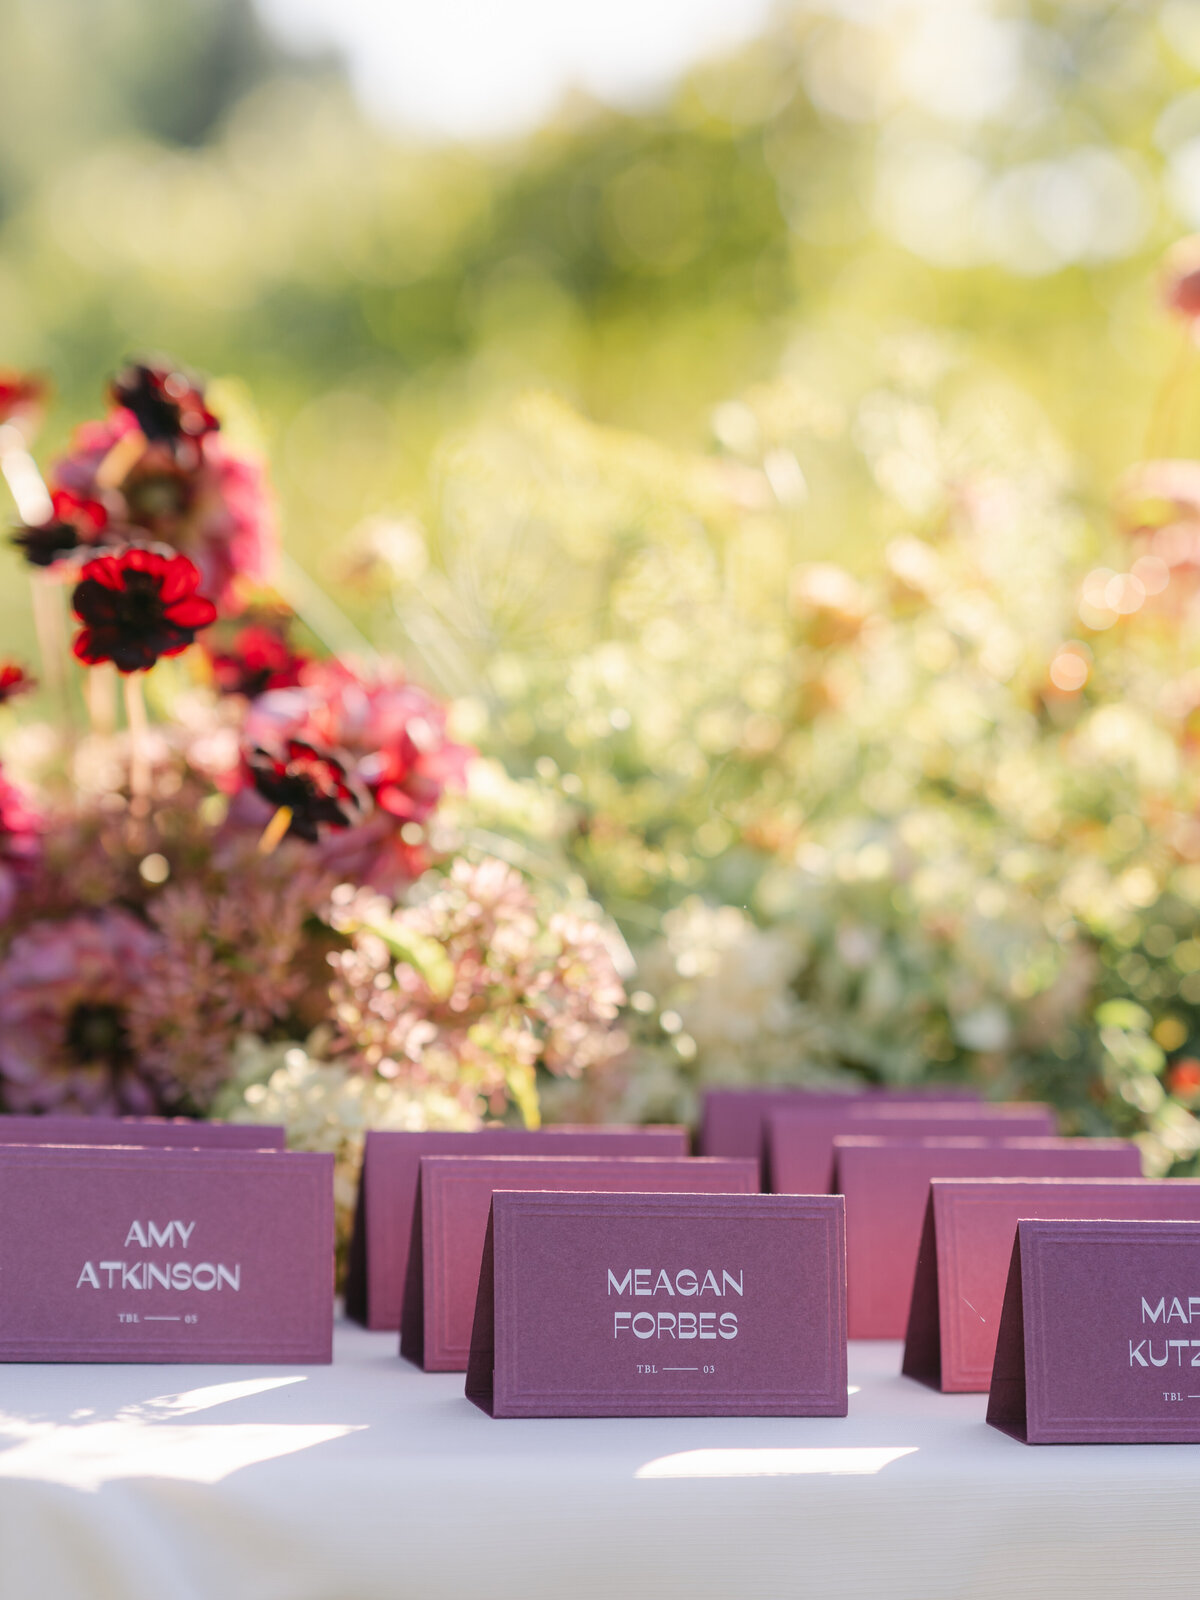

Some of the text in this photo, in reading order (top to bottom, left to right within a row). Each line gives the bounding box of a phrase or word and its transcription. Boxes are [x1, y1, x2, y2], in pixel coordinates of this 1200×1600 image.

[124, 1220, 195, 1248] AMY
[76, 1261, 241, 1291] ATKINSON
[607, 1268, 744, 1297] MEAGAN
[117, 1313, 198, 1324] TBL 05
[614, 1311, 739, 1340] FORBES
[636, 1364, 715, 1374] TBL 03
[1162, 1392, 1184, 1402] TBL
